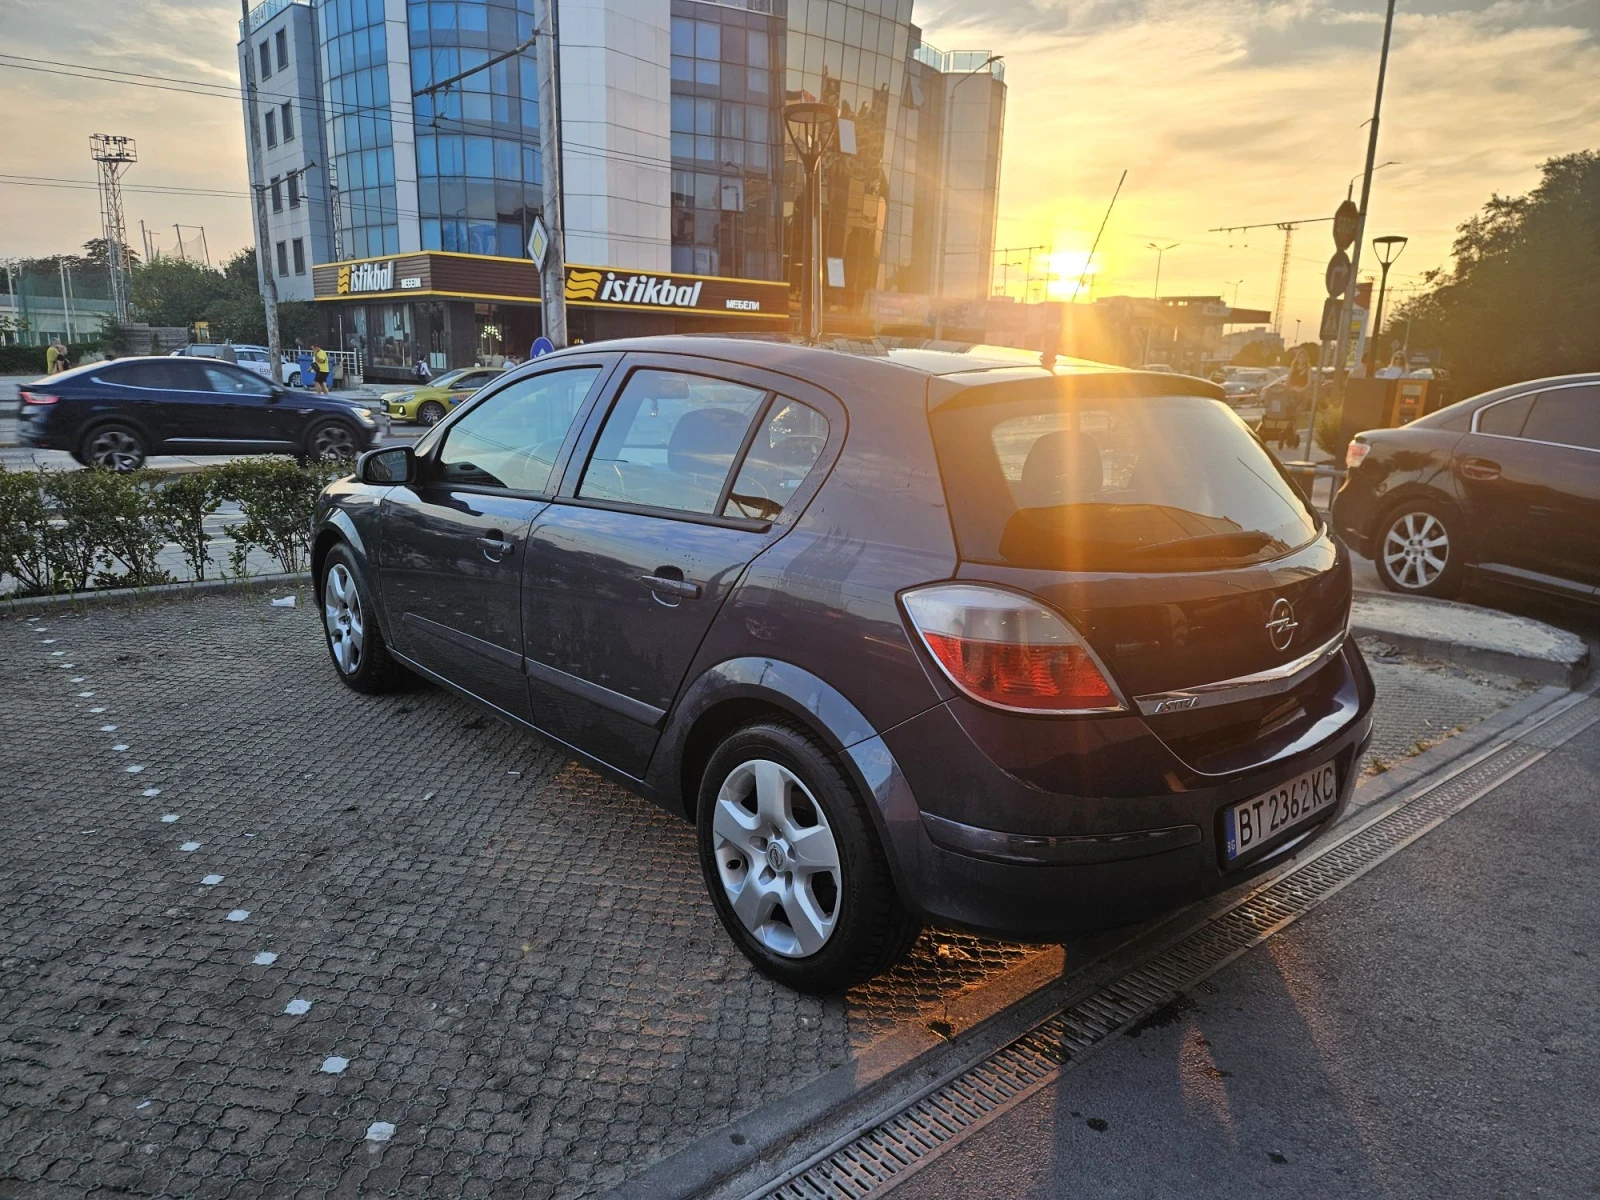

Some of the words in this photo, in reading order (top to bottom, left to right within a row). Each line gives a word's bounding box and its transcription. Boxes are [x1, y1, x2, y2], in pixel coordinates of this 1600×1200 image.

[350, 260, 392, 292] istikbal
[601, 272, 703, 307] istikbal
[726, 299, 760, 310] МЕБЕЛИ
